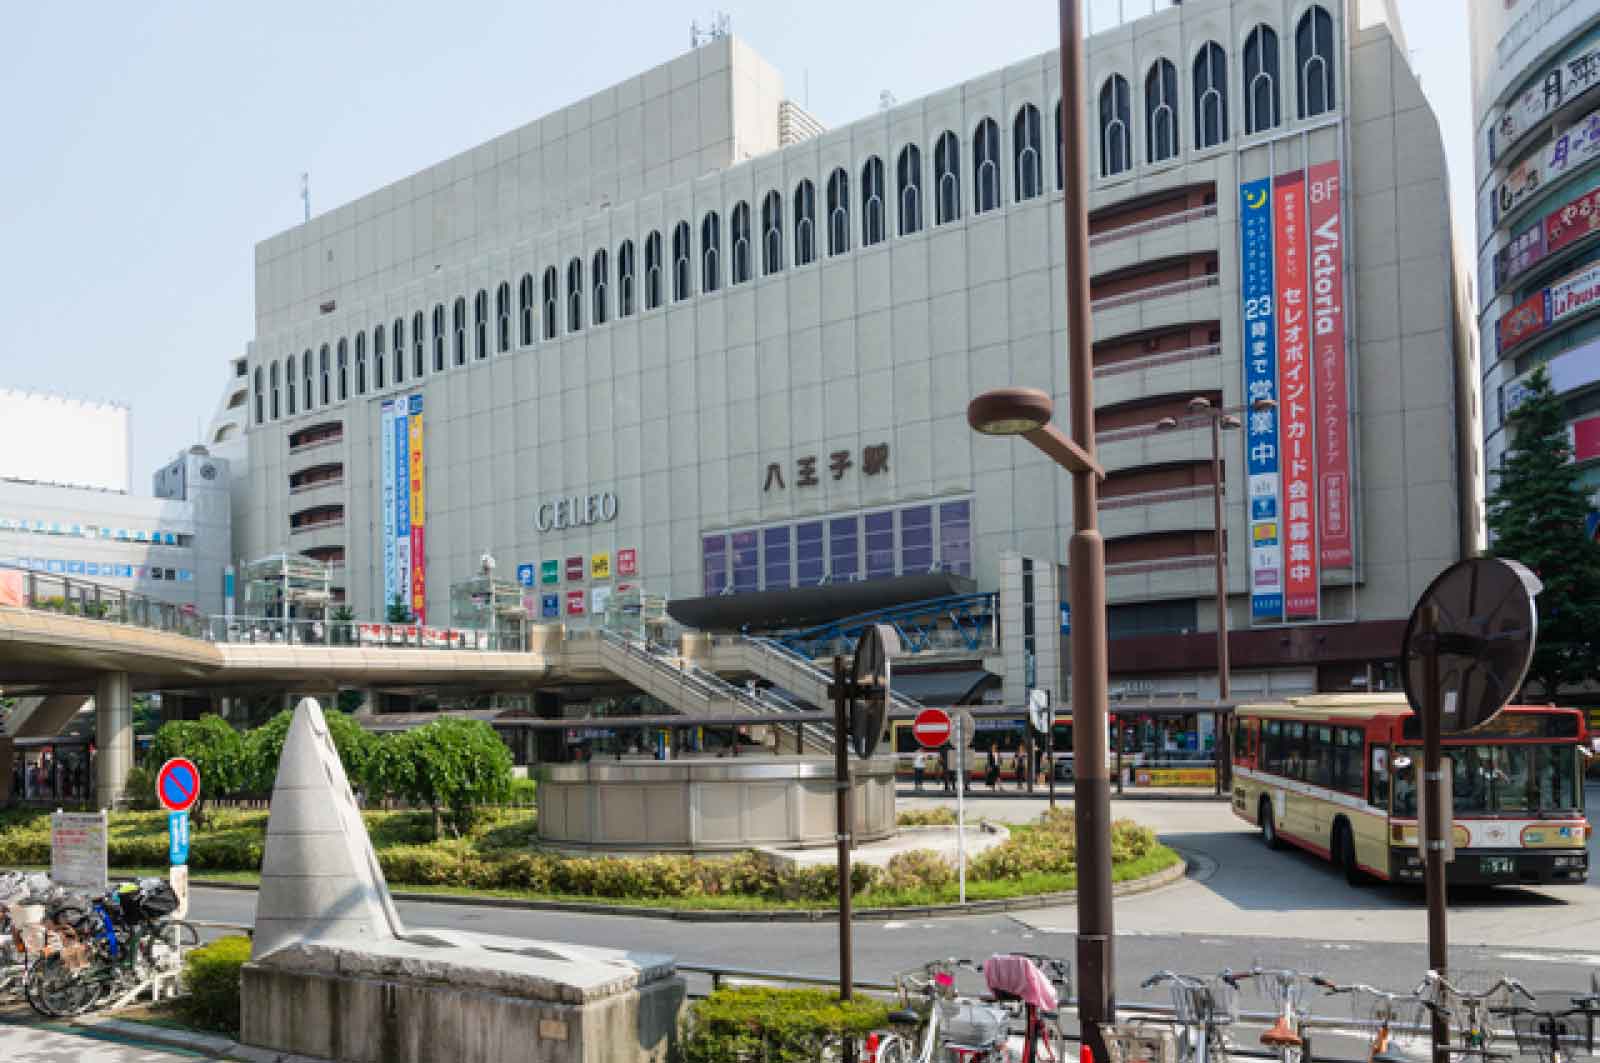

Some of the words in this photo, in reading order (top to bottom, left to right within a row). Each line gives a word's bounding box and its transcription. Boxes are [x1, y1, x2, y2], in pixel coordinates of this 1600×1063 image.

[1312, 213, 1341, 336] Victoria
[763, 442, 890, 492] 八王子駅
[535, 492, 619, 533] CELEO
